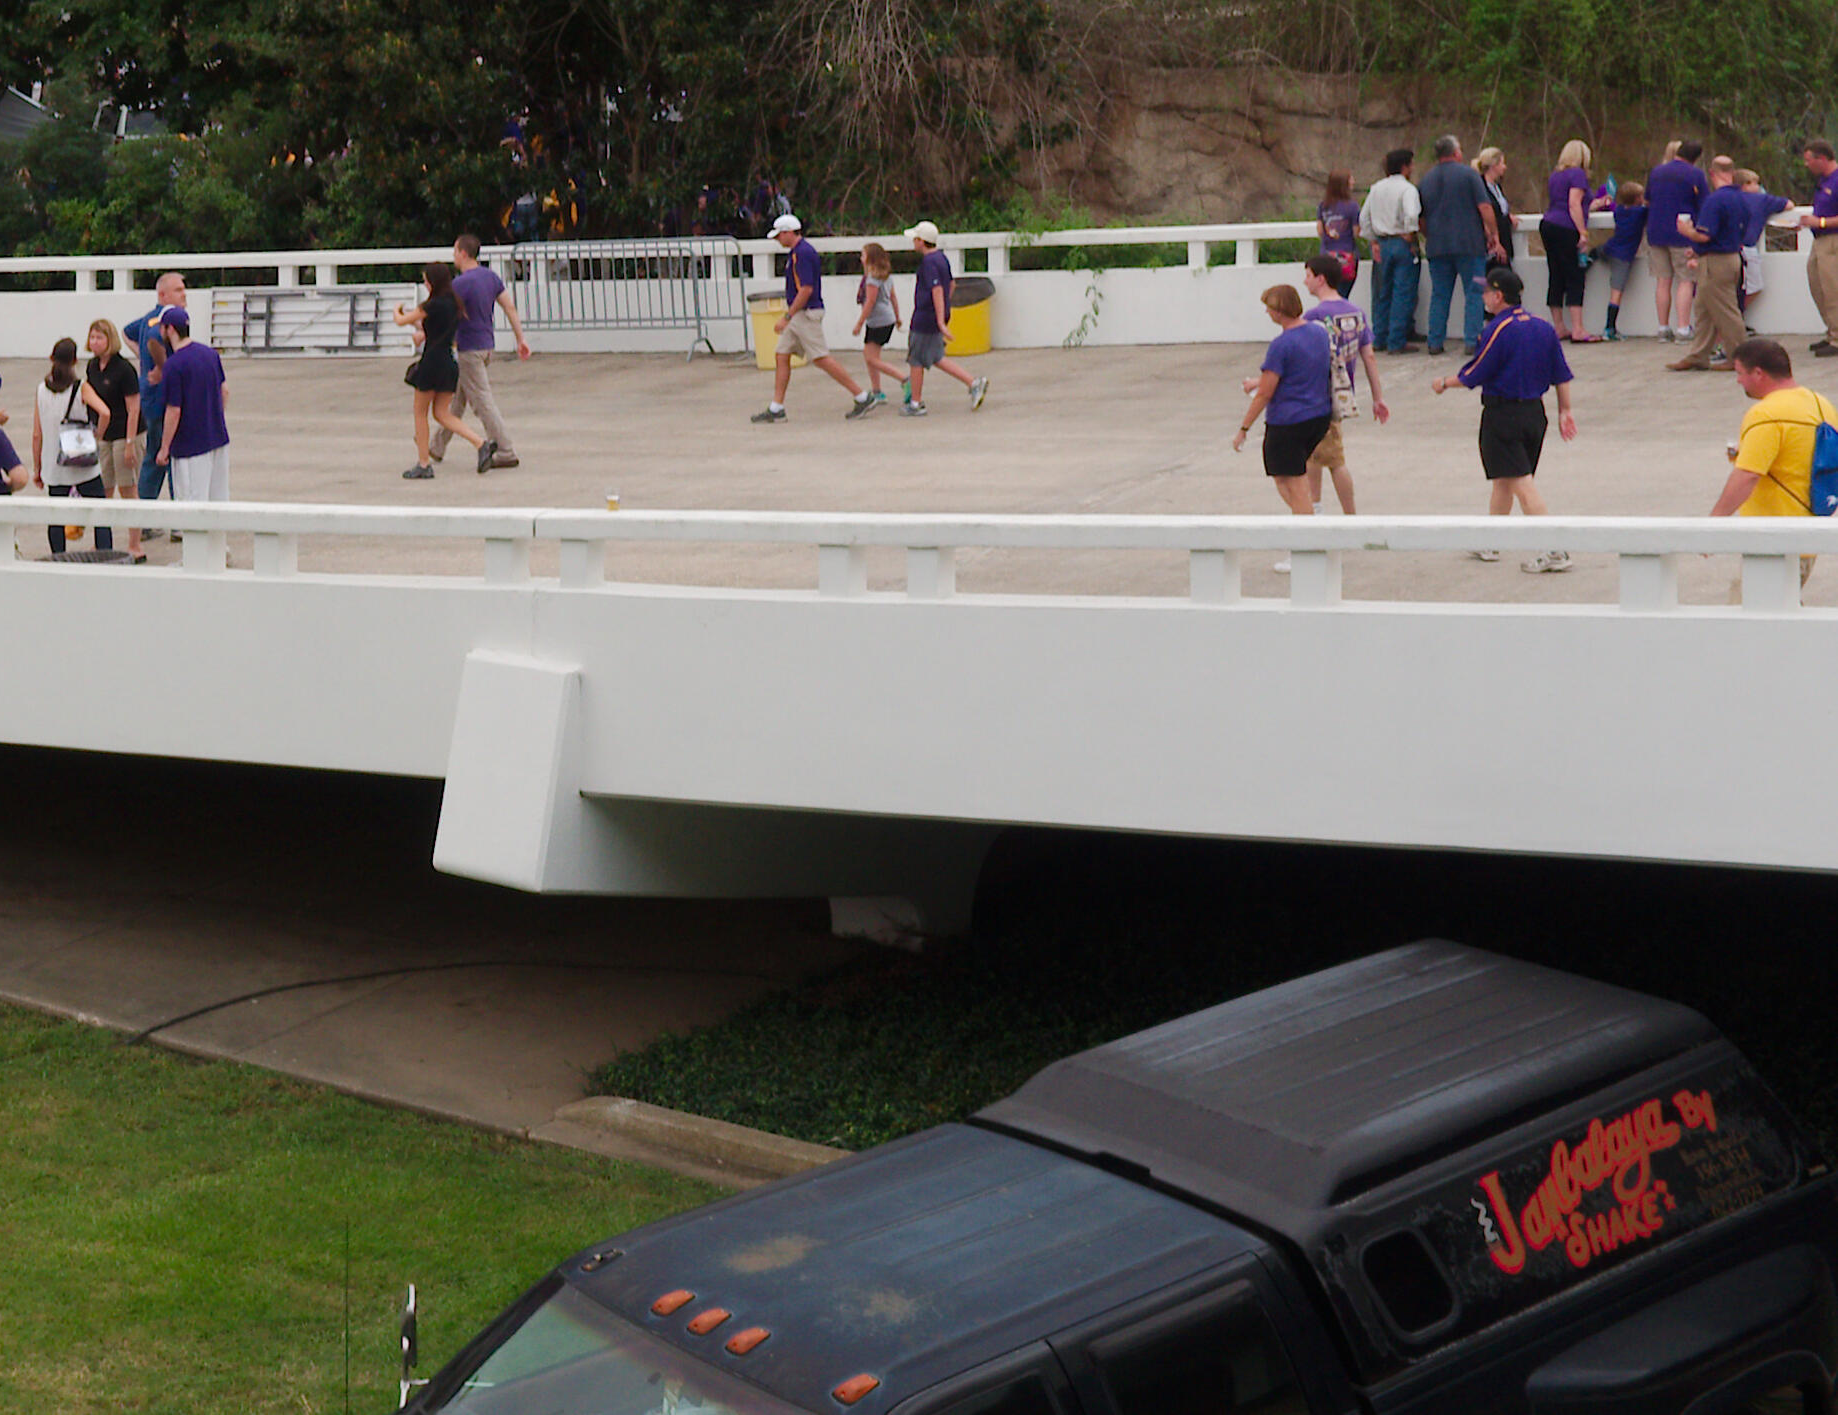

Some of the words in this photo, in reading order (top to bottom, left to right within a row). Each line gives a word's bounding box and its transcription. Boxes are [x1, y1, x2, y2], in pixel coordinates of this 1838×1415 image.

[1479, 1098, 1681, 1275] Jambalaya
[1672, 1089, 1717, 1132] By
[1566, 1189, 1664, 1268] SHAKE
